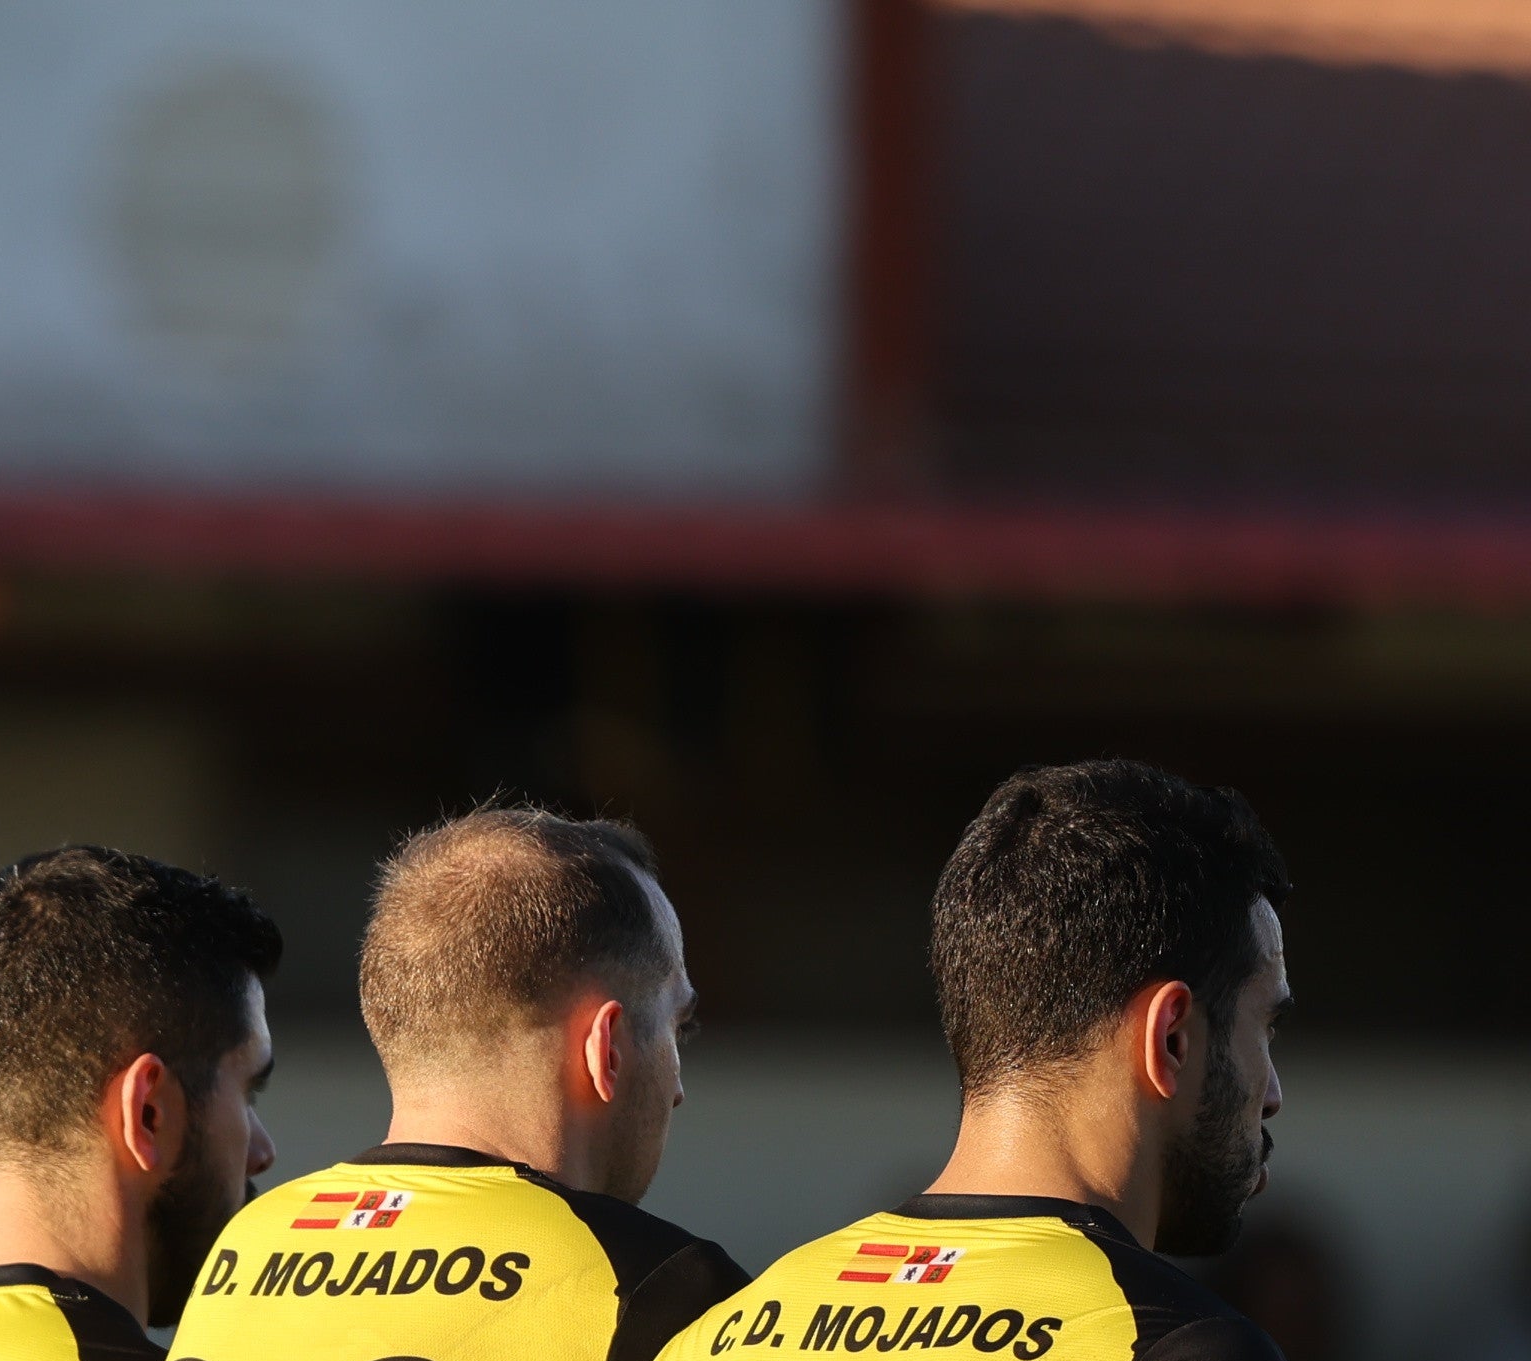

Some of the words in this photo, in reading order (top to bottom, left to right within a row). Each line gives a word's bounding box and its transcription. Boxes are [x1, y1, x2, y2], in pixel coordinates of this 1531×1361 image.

[250, 1246, 531, 1302] MOJADOS
[742, 1299, 786, 1348] D.
[799, 1303, 1063, 1361] MOJADOS
